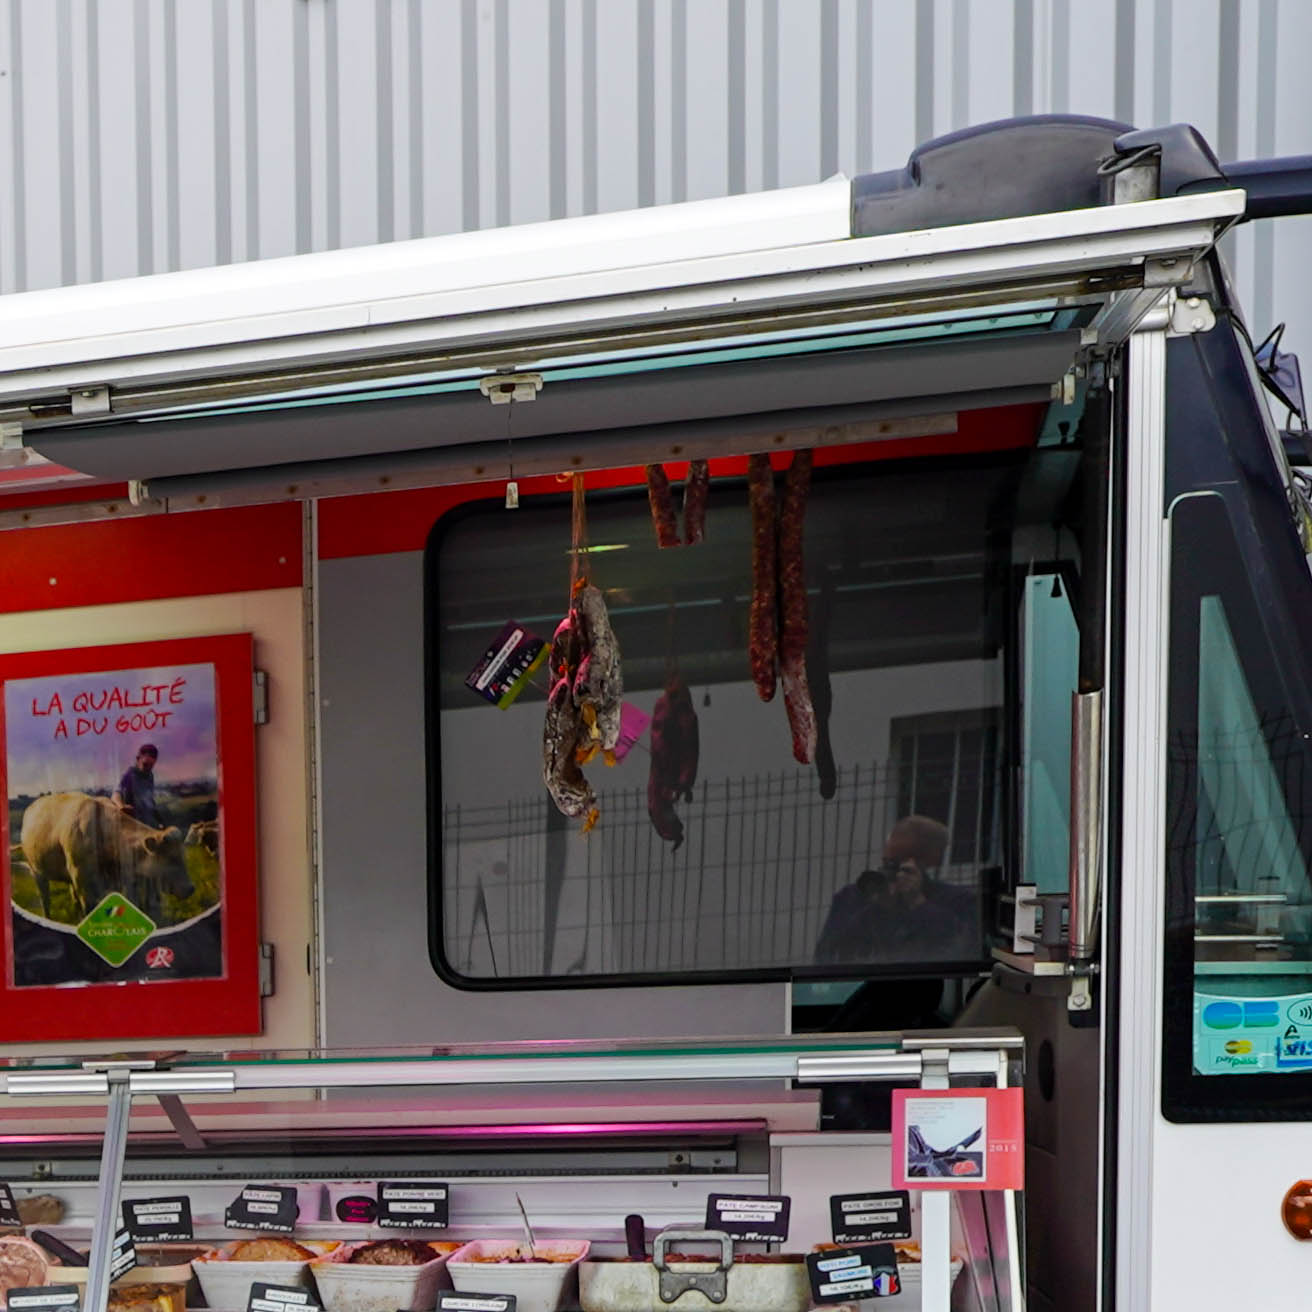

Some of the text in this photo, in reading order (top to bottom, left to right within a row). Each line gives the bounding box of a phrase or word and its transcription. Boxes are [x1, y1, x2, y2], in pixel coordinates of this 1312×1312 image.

[32, 677, 187, 716] LA QUALITÉ
[54, 709, 174, 739] A DU GOÛT
